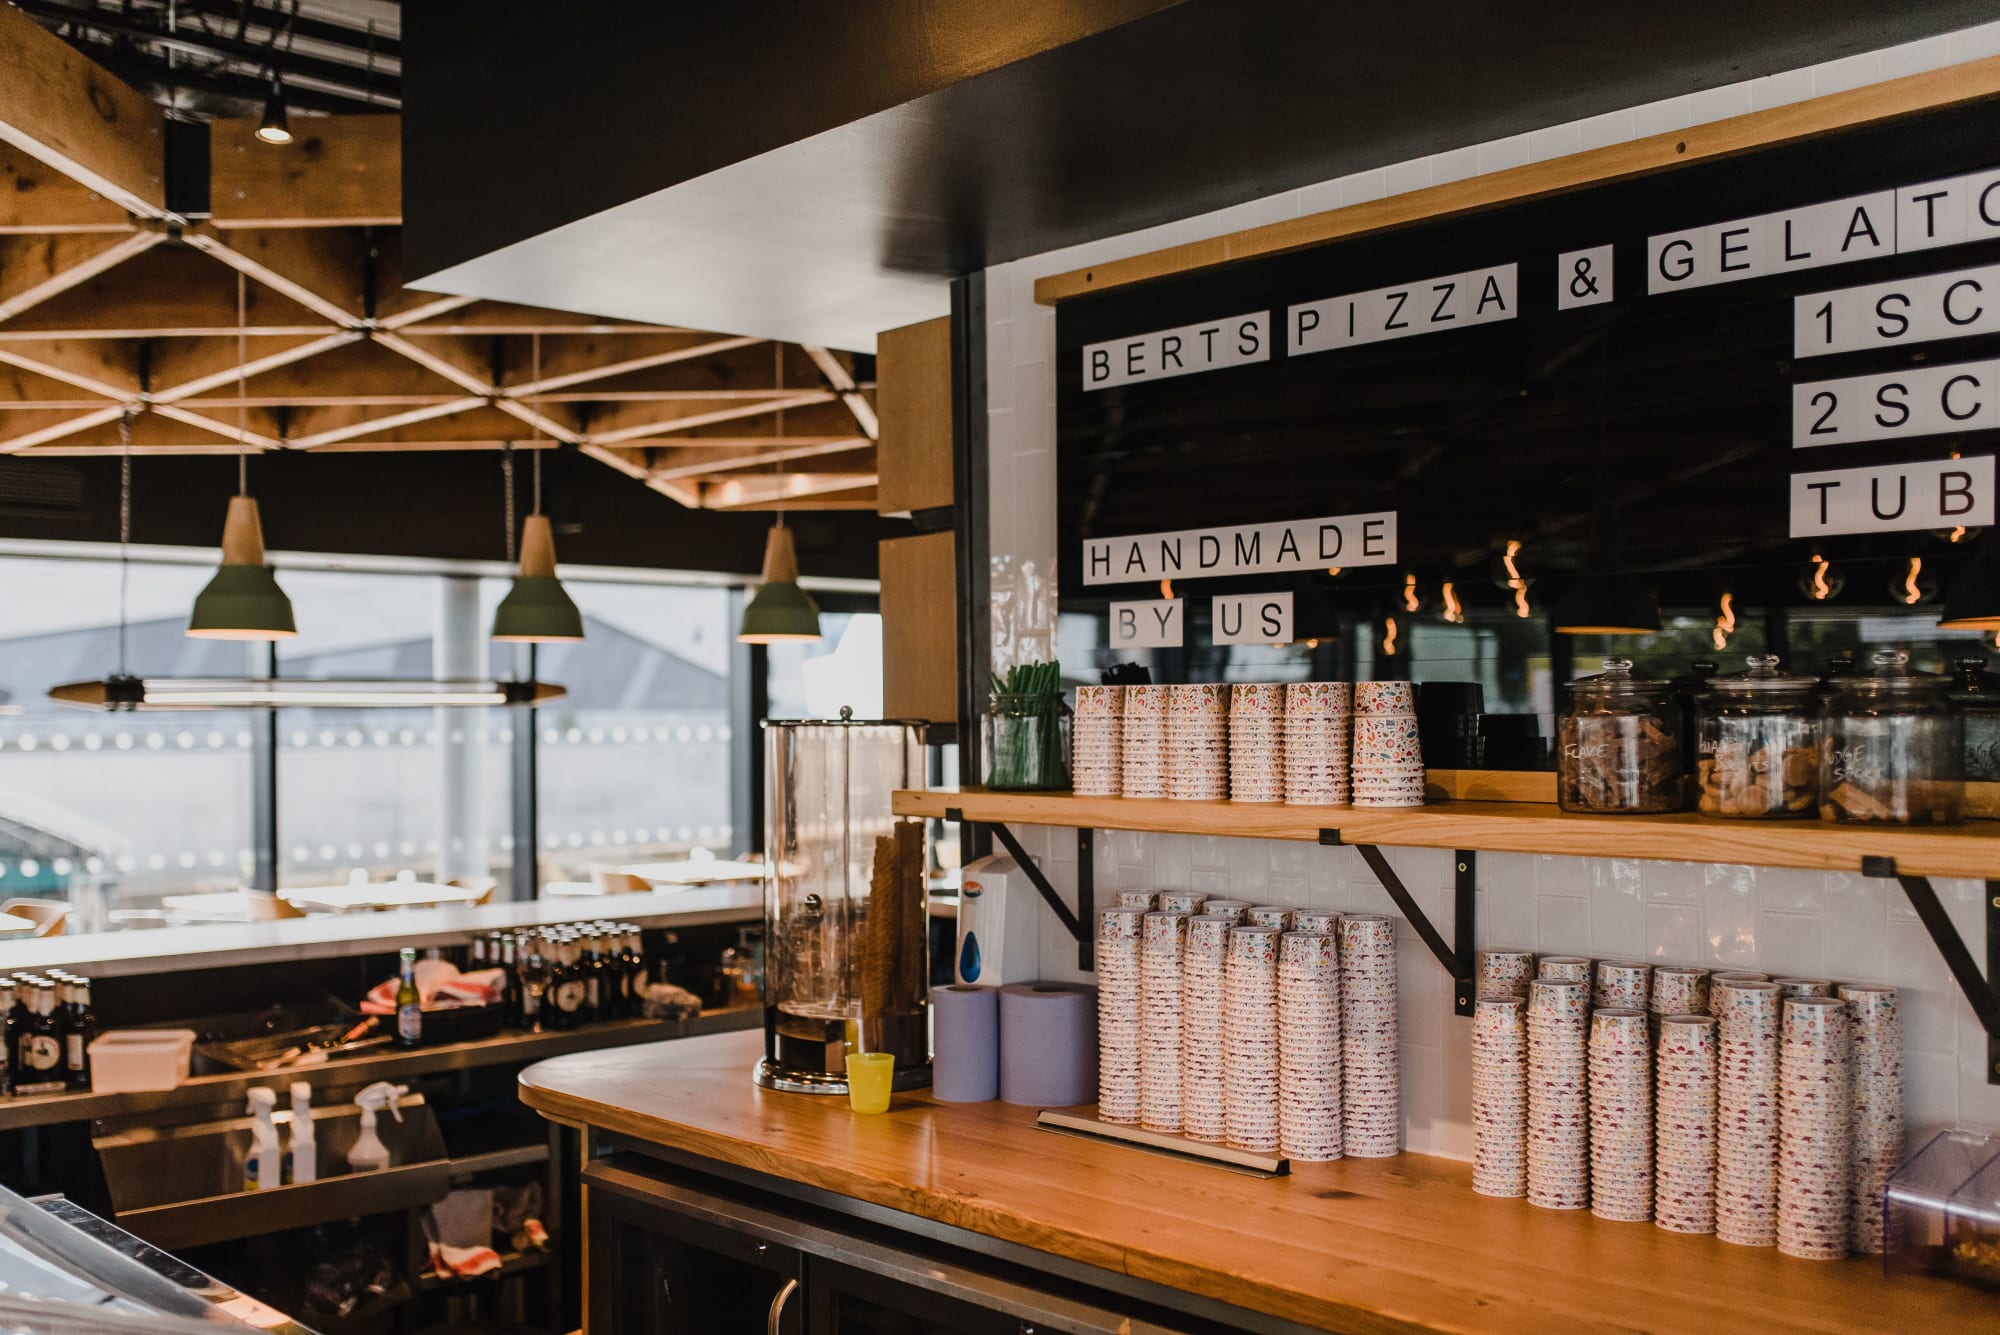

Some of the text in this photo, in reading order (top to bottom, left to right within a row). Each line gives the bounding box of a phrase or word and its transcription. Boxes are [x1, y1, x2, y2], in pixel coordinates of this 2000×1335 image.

[1092, 321, 1260, 383] BERTS
[1298, 275, 1507, 347] PIZZA
[1570, 257, 1600, 299] &
[1806, 470, 1975, 525] TUB
[1091, 519, 1386, 577] HANDMADE
[1118, 602, 1283, 640] BY US
[1564, 743, 1610, 761] FLAKE
